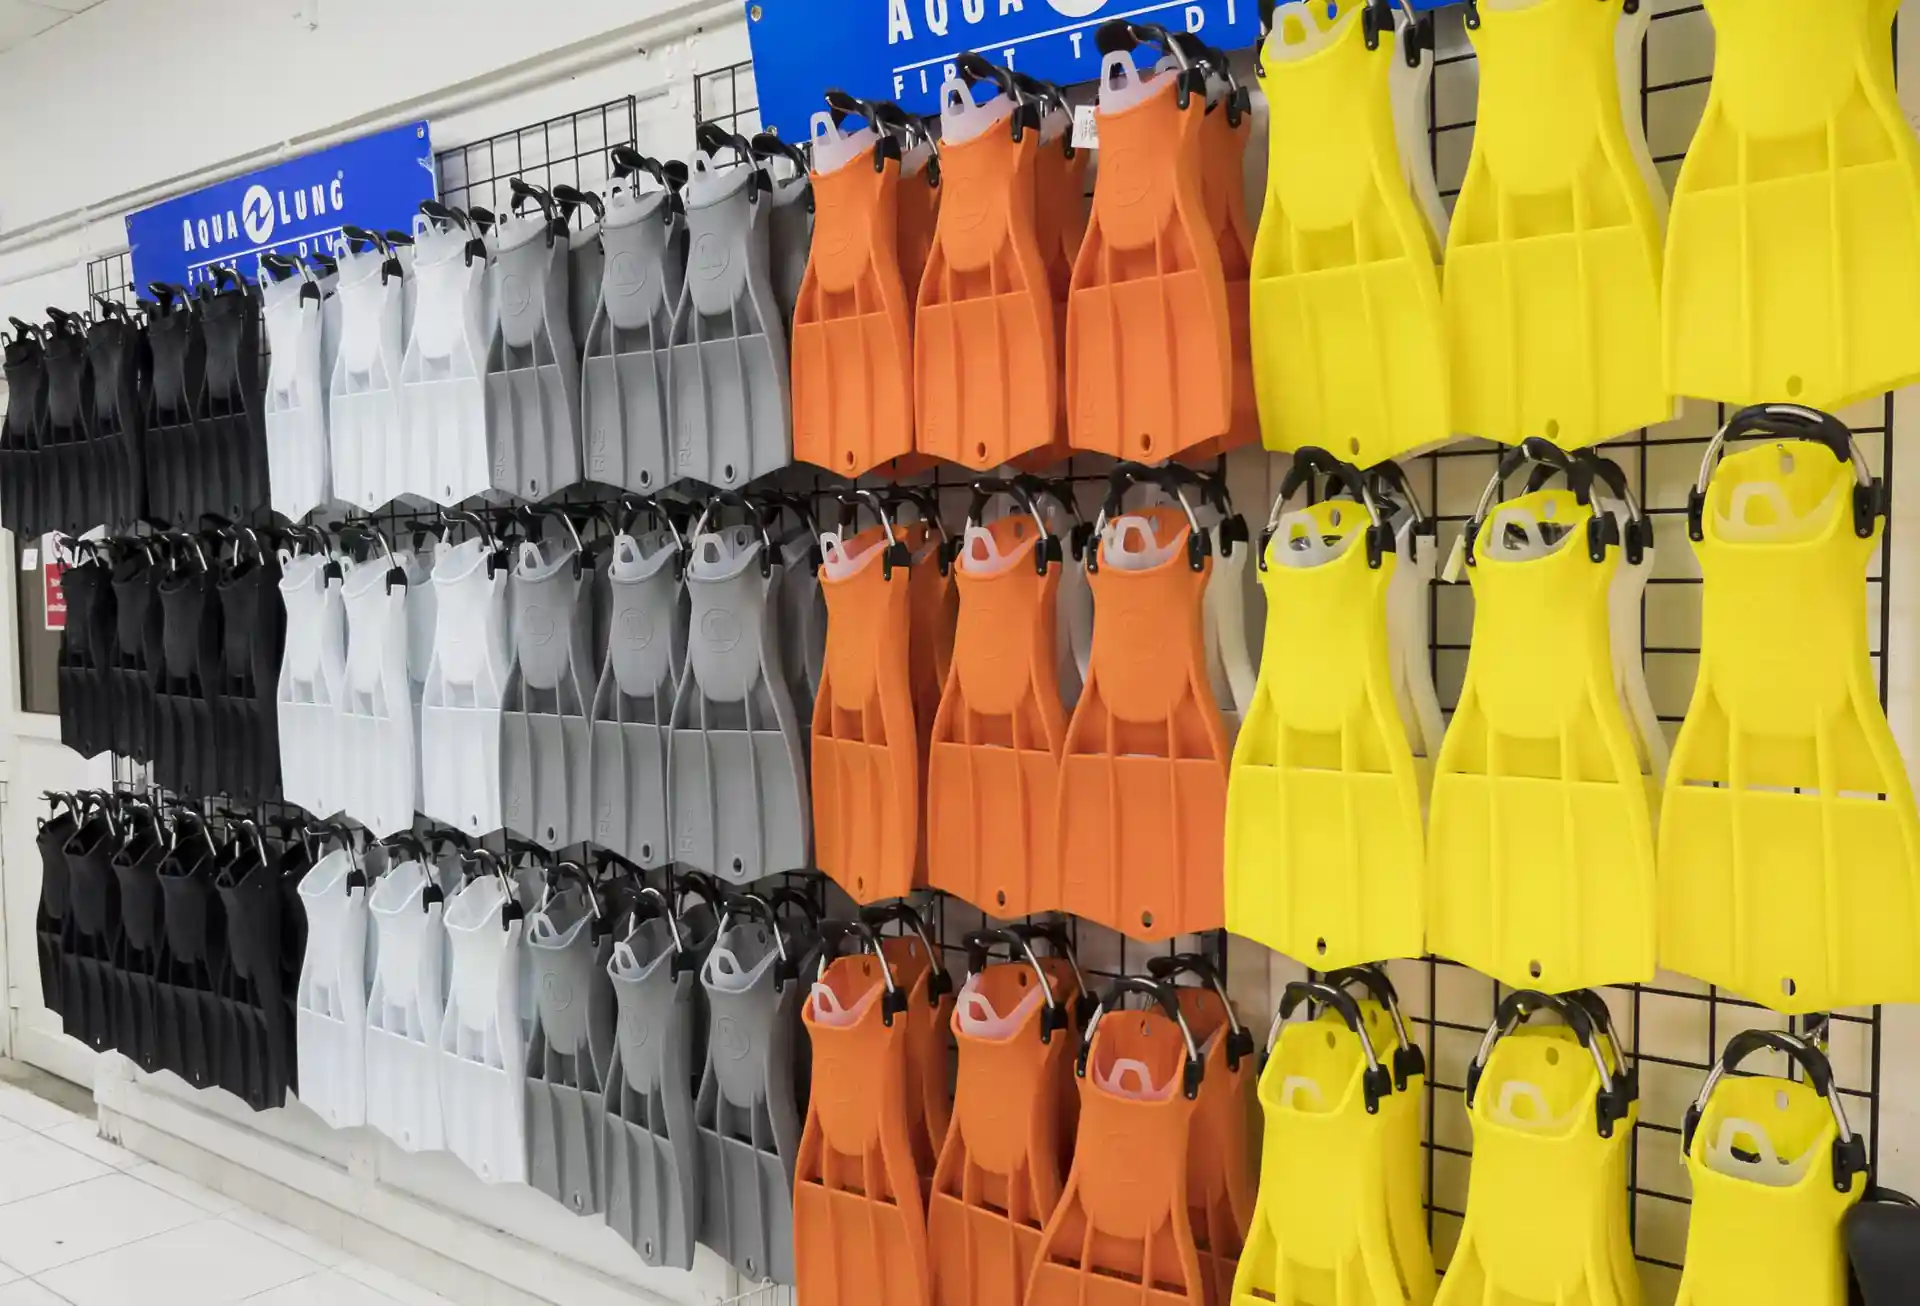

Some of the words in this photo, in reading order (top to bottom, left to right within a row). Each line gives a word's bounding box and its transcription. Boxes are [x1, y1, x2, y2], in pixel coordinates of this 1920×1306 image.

[893, 48, 1016, 100] FIRT
[183, 210, 239, 252] AQUA
[299, 235, 337, 259] DIV
